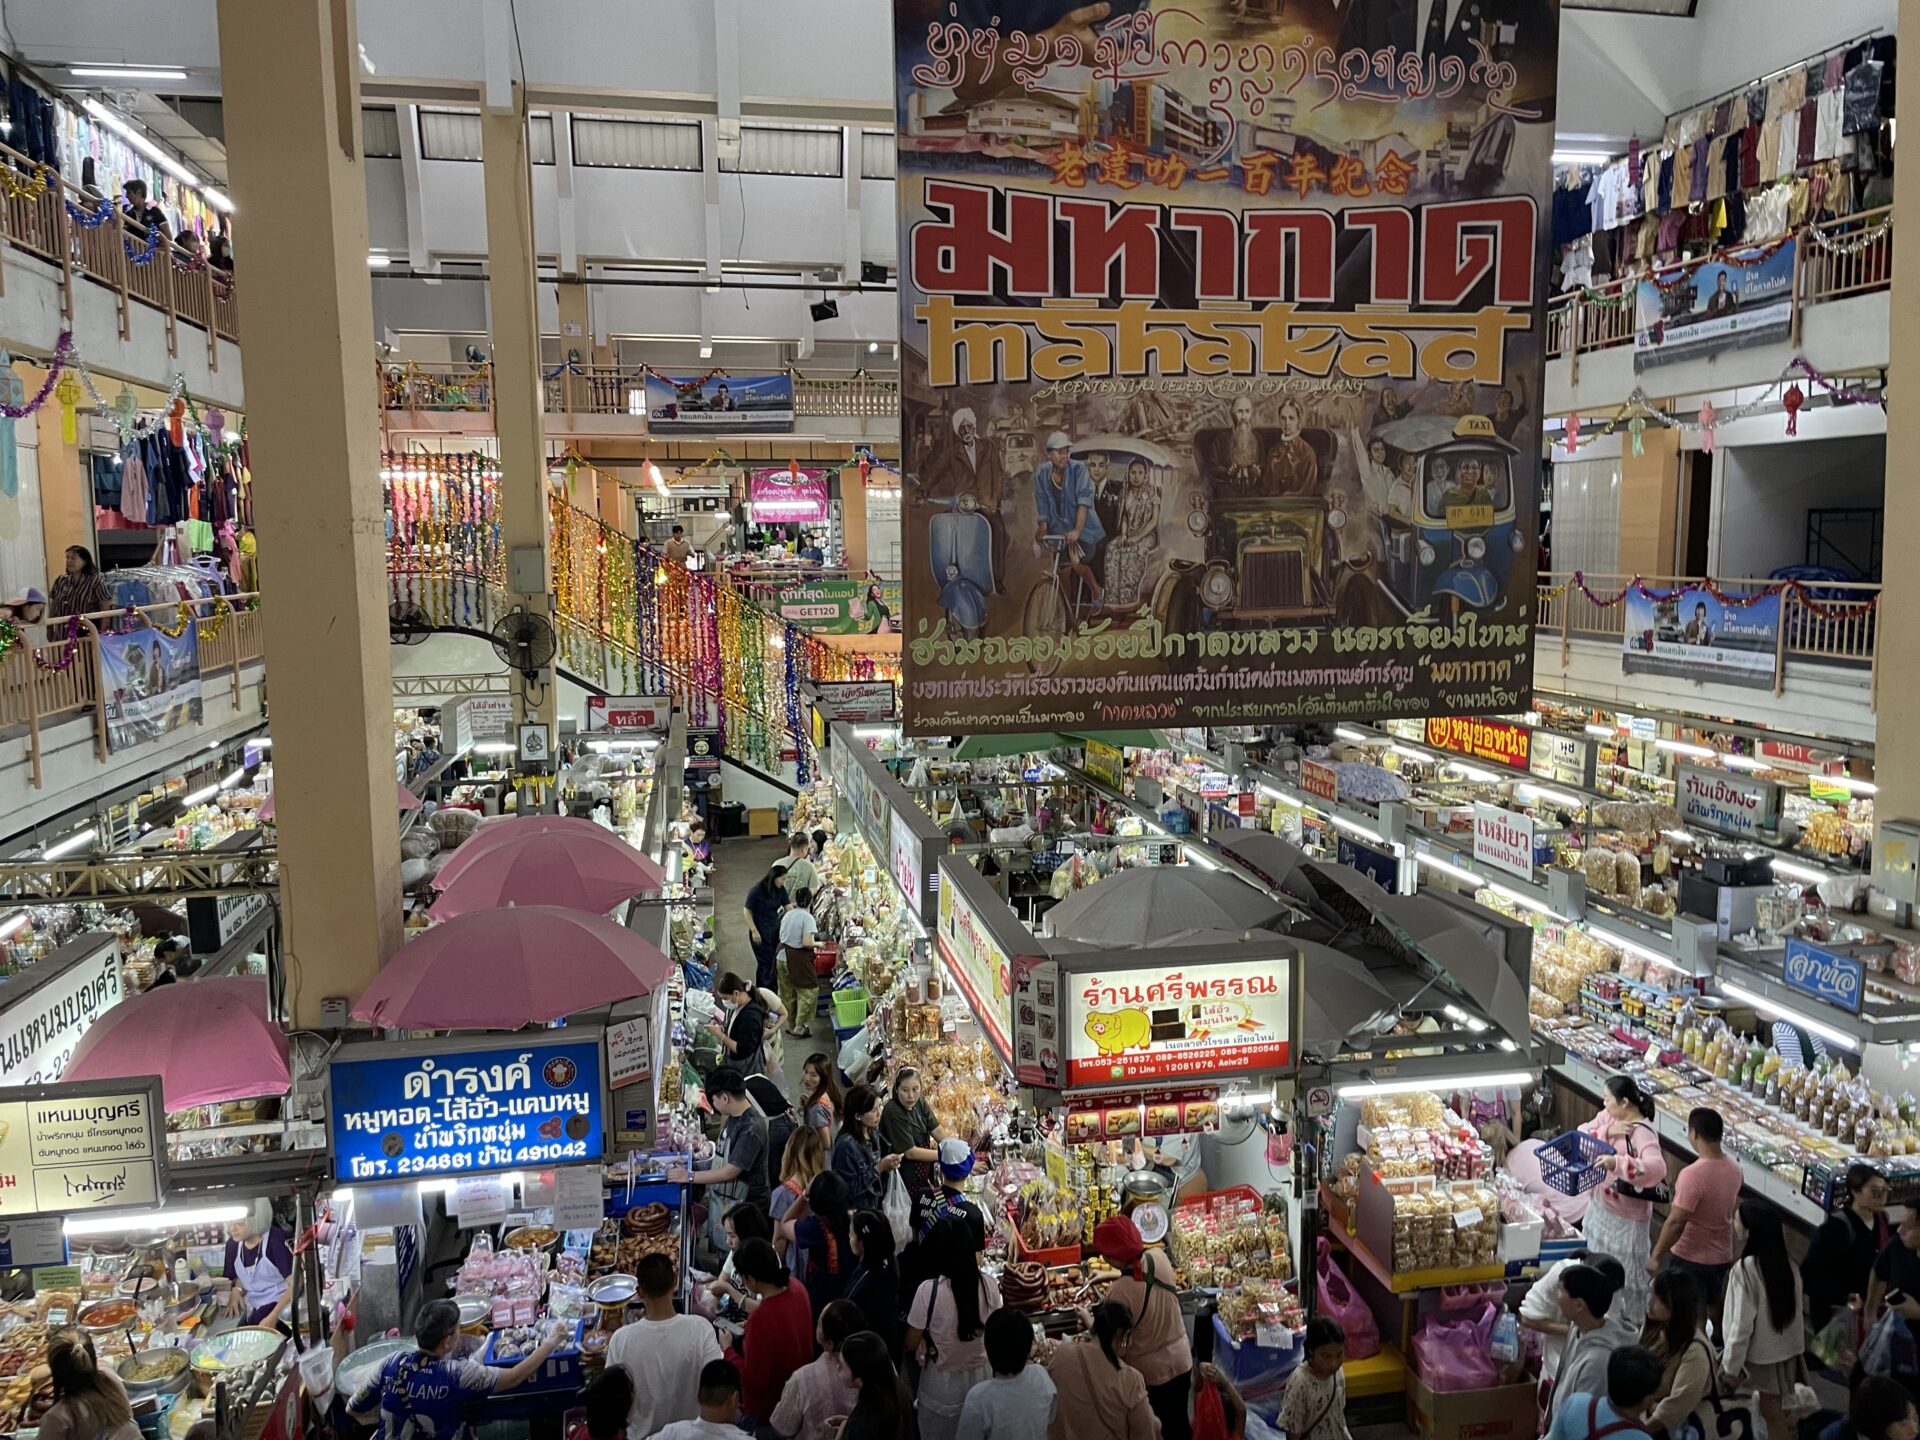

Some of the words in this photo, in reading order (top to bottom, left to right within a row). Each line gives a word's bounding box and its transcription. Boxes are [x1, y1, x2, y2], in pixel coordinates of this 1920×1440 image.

[911, 178, 1537, 305] มหากาด
[915, 297, 1531, 387] mahakad
[800, 607, 835, 616] GET120
[1478, 815, 1529, 852] เหมียว
[1083, 972, 1278, 1006] ร้านศรีพรรณ
[404, 1053, 533, 1100] ดำรงค์
[1127, 1066, 1137, 1075] ID
[1140, 1065, 1156, 1074] Line
[38, 1100, 140, 1125] แหนมบุญศรี
[344, 1091, 590, 1134] หมูทอด-ไส้อั่ว-แคบหมู
[351, 1155, 392, 1178] โทร.
[398, 1152, 473, 1174] 234661
[478, 1144, 513, 1166] บ้าน
[516, 1140, 587, 1162] 491042
